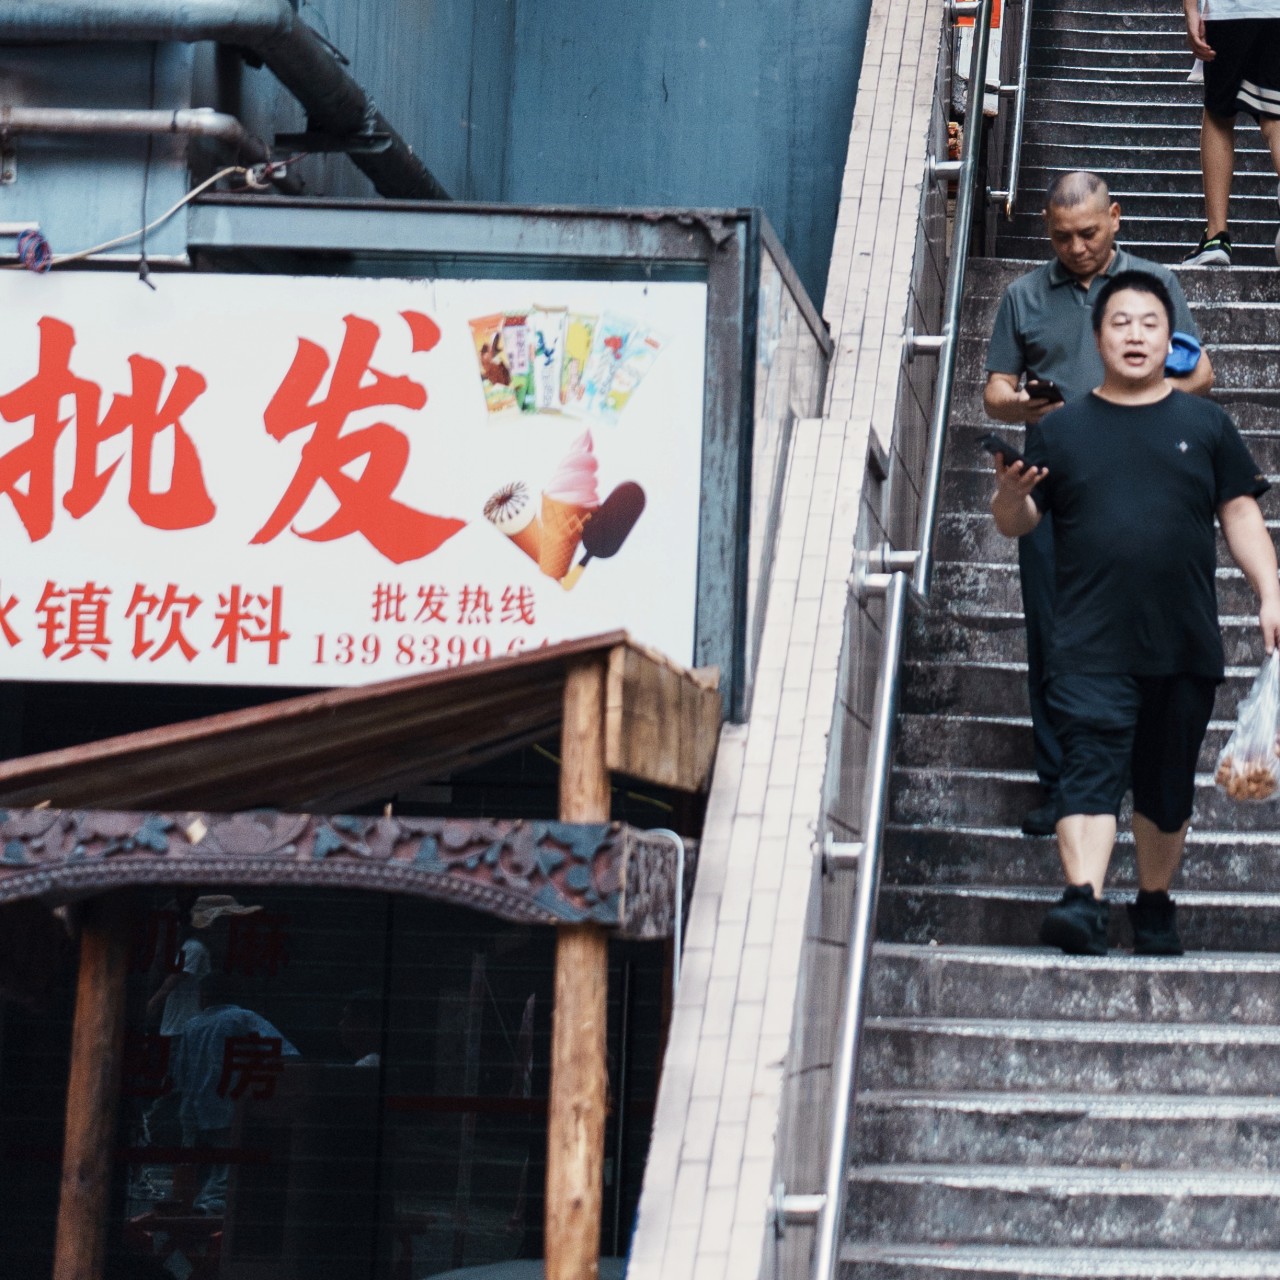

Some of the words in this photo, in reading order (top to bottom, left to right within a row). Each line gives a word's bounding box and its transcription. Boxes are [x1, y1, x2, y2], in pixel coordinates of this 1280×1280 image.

[0, 311, 469, 564] 批发
[371, 582, 536, 625] 批发热线
